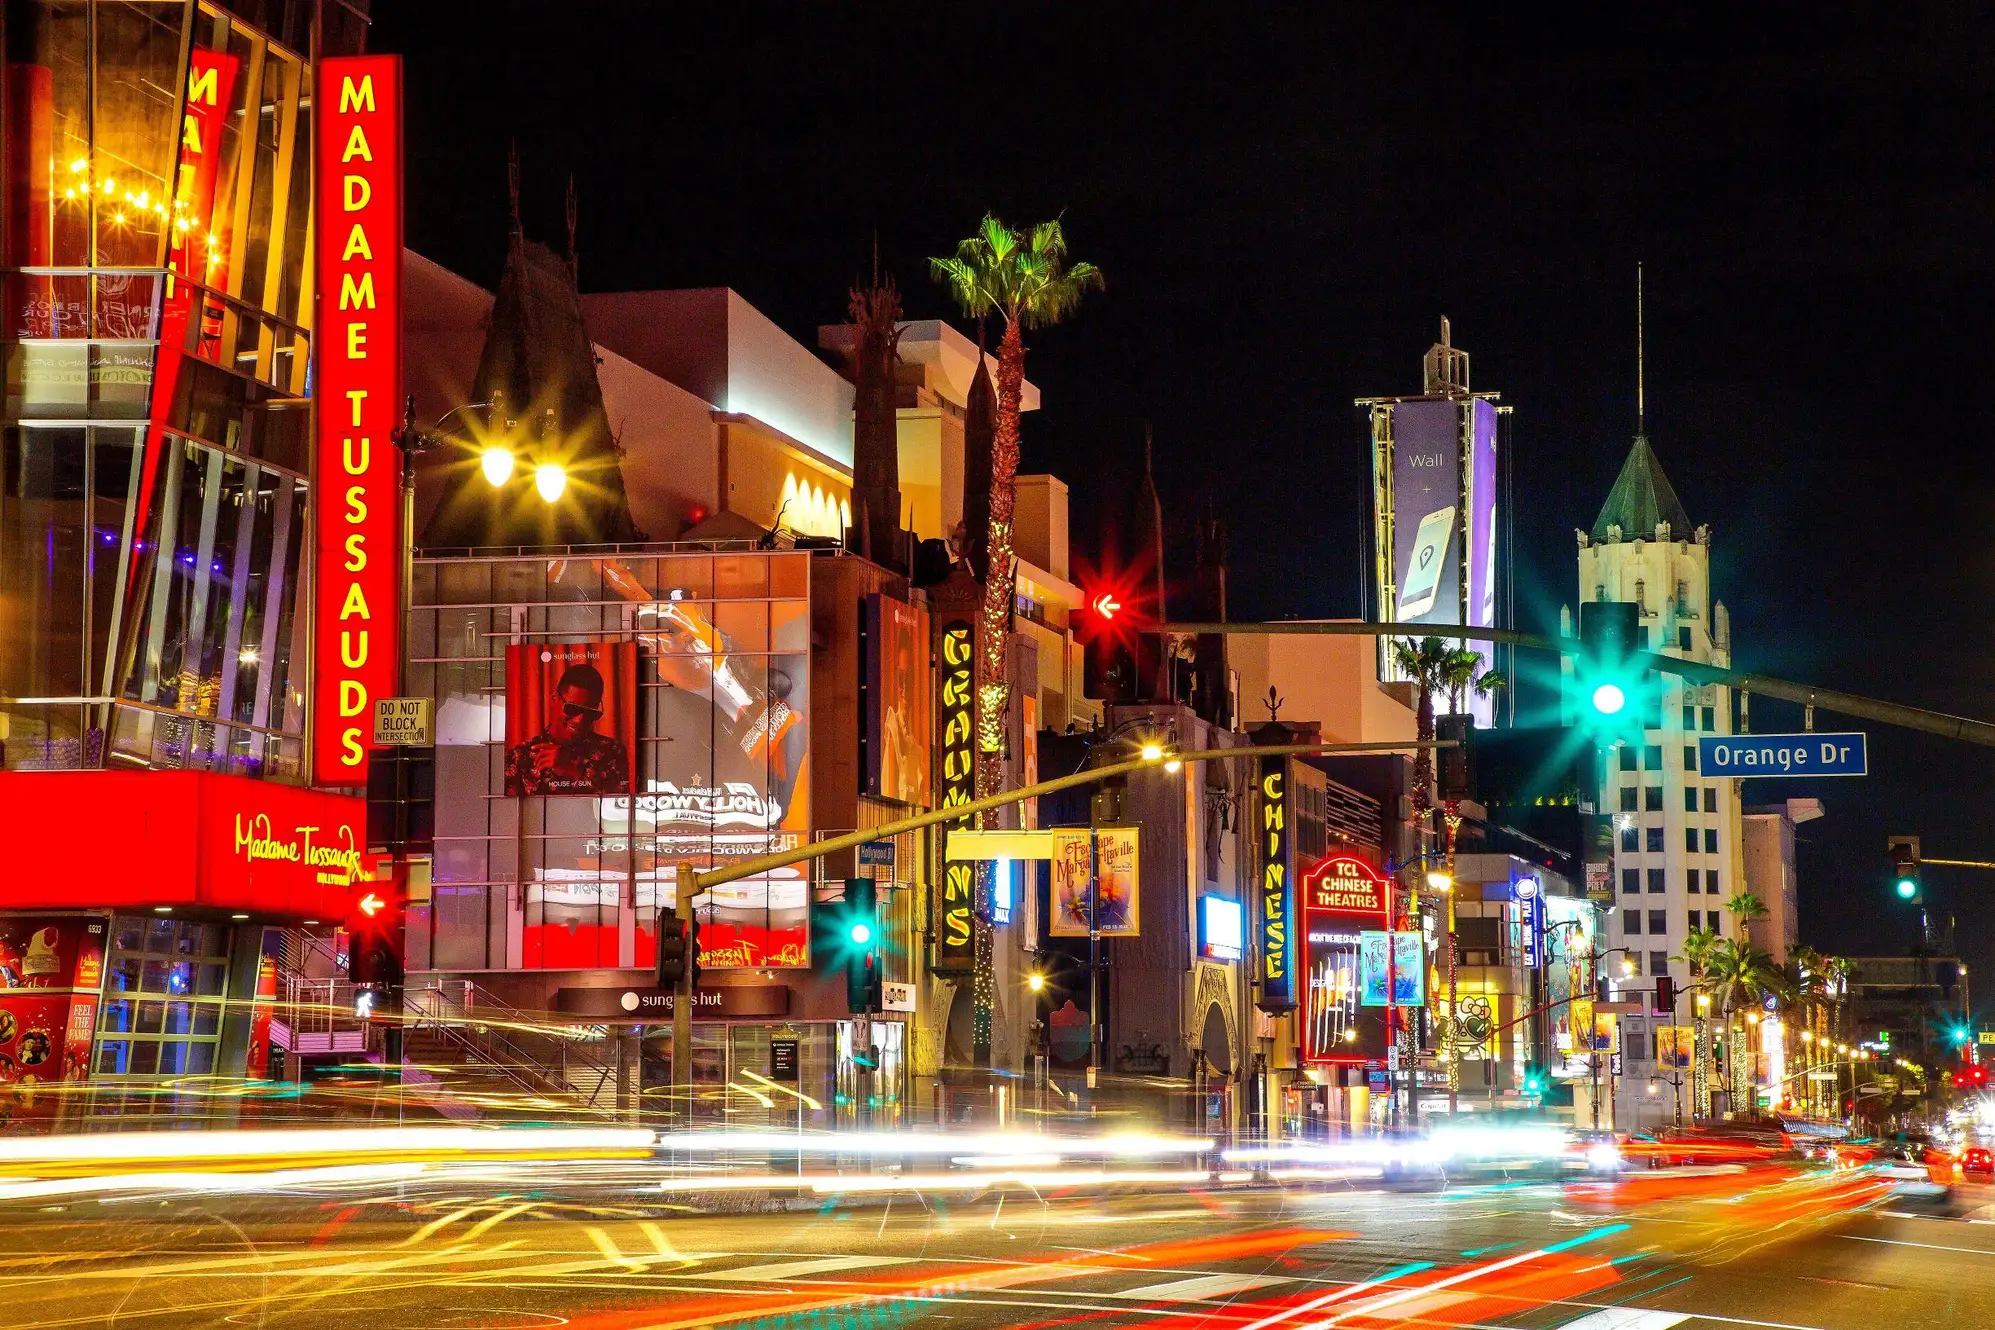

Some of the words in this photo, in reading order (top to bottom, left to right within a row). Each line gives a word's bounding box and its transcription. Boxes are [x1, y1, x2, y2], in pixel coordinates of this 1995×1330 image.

[339, 74, 376, 360] MADAME
[1408, 453, 1444, 468] Wall
[339, 389, 371, 767] TUSSAUDS
[553, 651, 586, 661] sunglass
[587, 651, 600, 660] hut
[380, 702, 395, 715] DO
[400, 702, 421, 715] NOT
[383, 717, 417, 731] BLOCK
[375, 731, 425, 741] INTERSECTION
[1714, 744, 1808, 772] Orange
[1820, 743, 1851, 764] Dr
[944, 629, 972, 947] GRAUMNS
[235, 812, 300, 862] Madame
[295, 824, 362, 882] Tussauds
[861, 846, 887, 859] Hollywood
[1336, 862, 1359, 877] TCL
[1586, 863, 1608, 873] BIRDS
[1263, 772, 1285, 979] CHINESE
[1587, 873, 1596, 882] OF
[1322, 877, 1373, 892] CHINESE
[1587, 882, 1605, 891] PREY
[1317, 892, 1378, 908] THEATRES
[88, 925, 102, 933] 6933
[642, 995, 698, 1009] sungs
[700, 991, 722, 1006] hut
[74, 1004, 92, 1016] FEEL
[74, 1017, 90, 1028] THE
